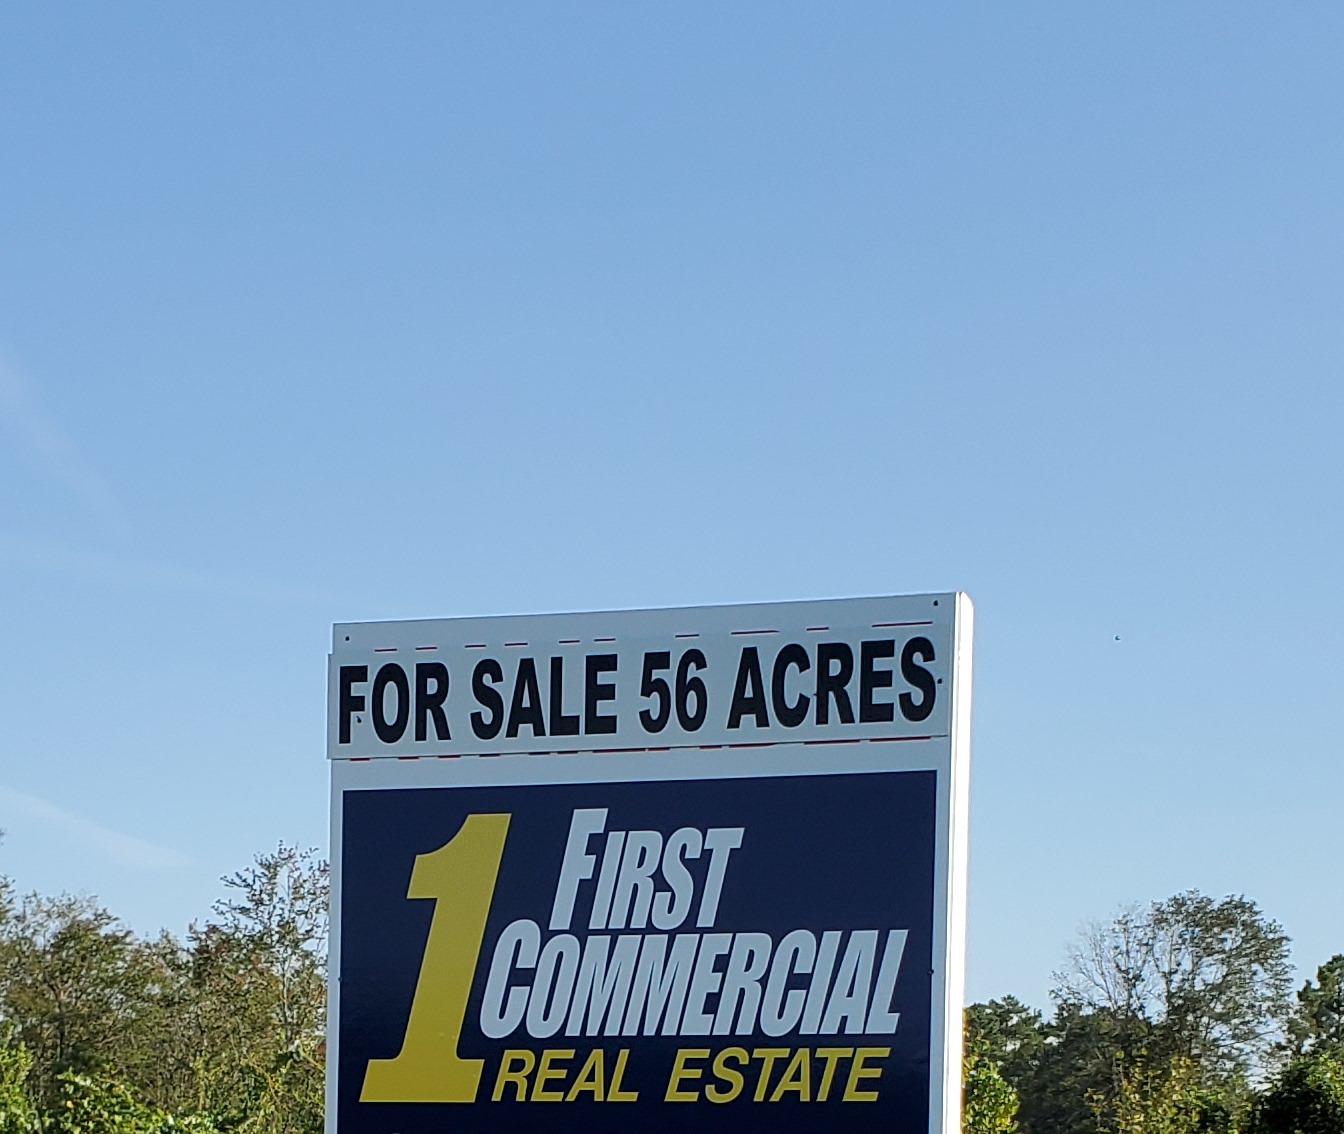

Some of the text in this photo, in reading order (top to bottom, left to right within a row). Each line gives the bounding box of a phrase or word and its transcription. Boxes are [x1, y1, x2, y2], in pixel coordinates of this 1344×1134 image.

[338, 636, 937, 744] FOR SALE 56 ACRES
[549, 807, 745, 930] FIRST
[359, 812, 512, 1103] 1
[480, 919, 909, 1039] COMMERCIAL
[491, 1046, 891, 1103] REAL ESTATE
